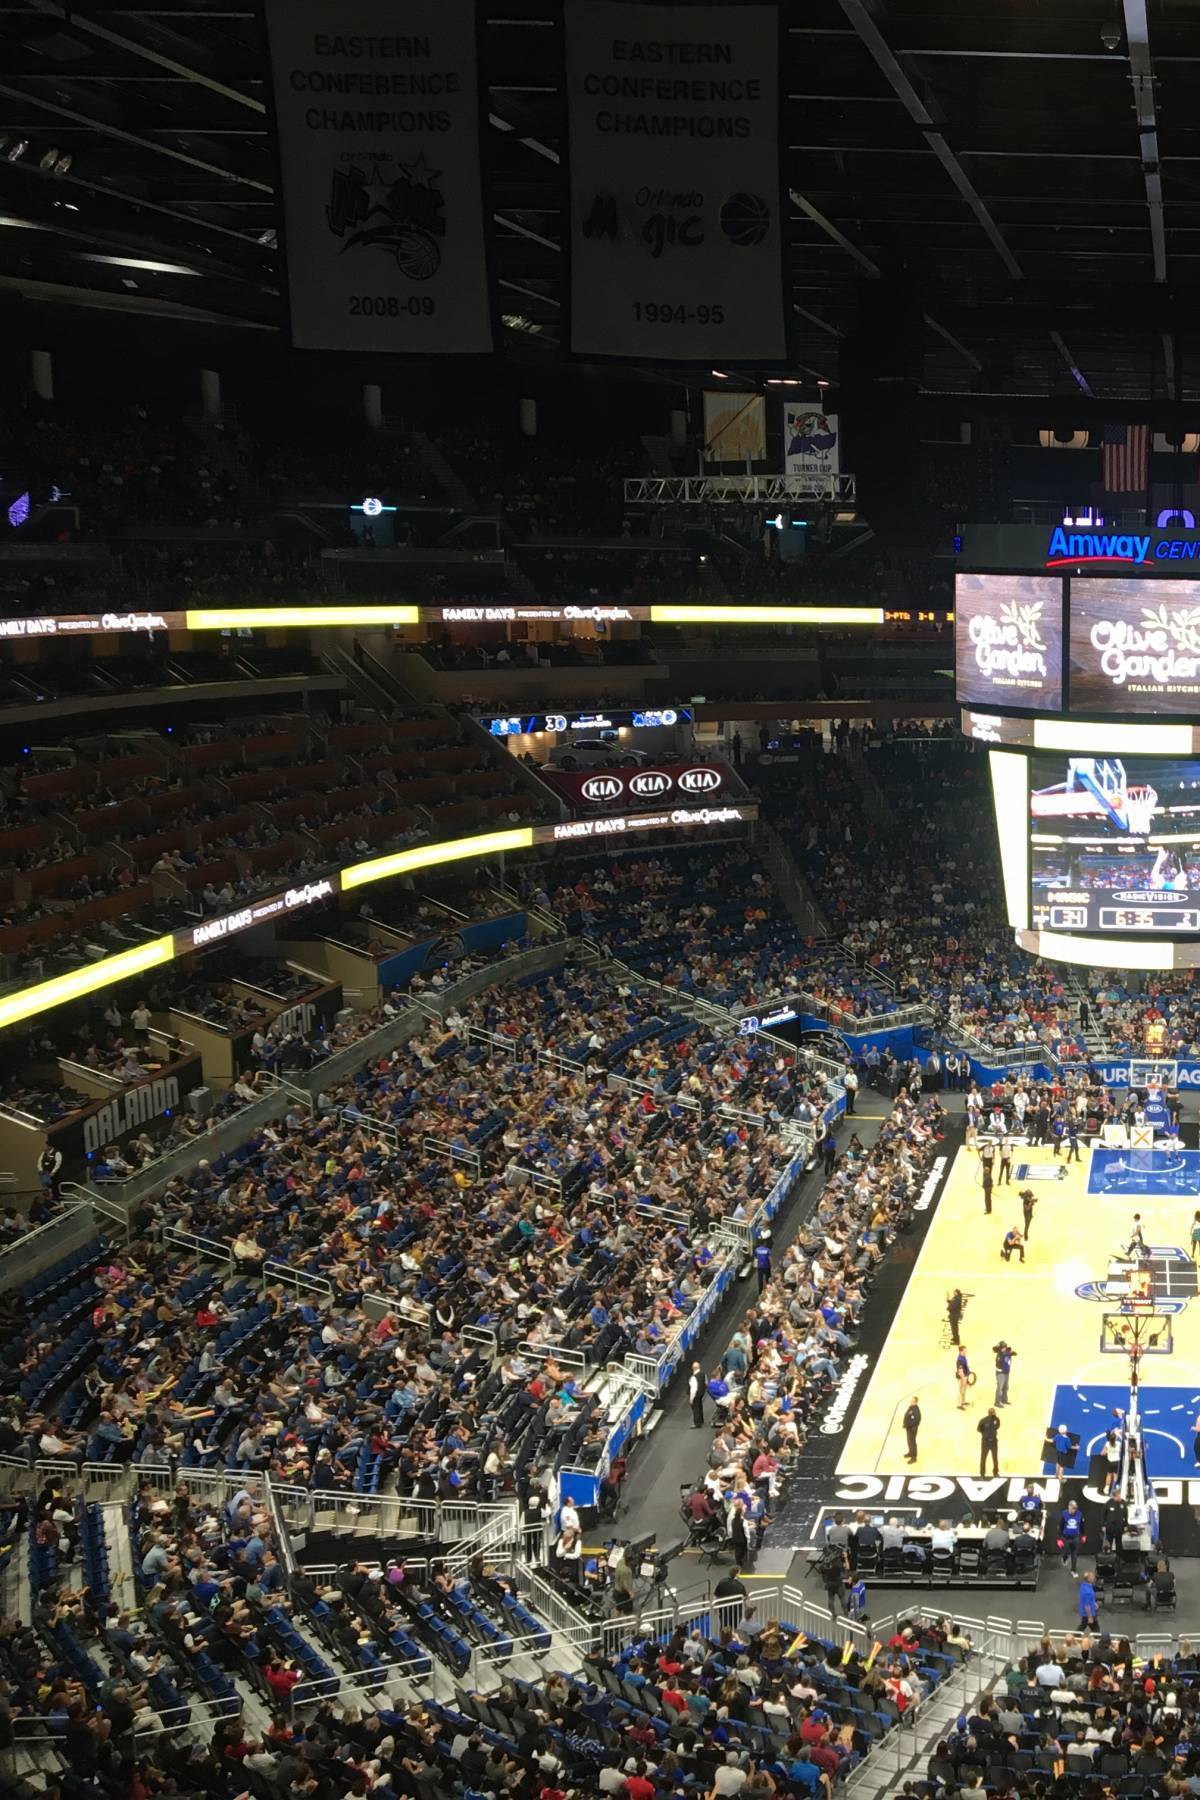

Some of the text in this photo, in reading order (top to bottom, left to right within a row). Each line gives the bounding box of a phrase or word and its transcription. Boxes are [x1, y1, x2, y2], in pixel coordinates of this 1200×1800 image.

[314, 34, 431, 57] EASTERN
[612, 40, 732, 64] EASTERN
[290, 70, 460, 95] CONFERENCE
[584, 73, 761, 100] CONFERENCE
[305, 108, 451, 132] CHAMPIONS
[595, 112, 750, 138] CHAMPIONS
[634, 186, 704, 209] Orlando
[349, 296, 435, 316] 2008-09
[632, 302, 724, 324] 1994-95
[1049, 527, 1150, 565] Amway
[443, 608, 484, 620] FAMILY
[486, 608, 515, 619] DAYS
[0, 620, 26, 636] AMILY
[27, 619, 57, 634] DAYS
[968, 615, 1019, 646] Olive
[1090, 620, 1168, 651] Olive
[975, 643, 1047, 677] Garden
[1128, 684, 1164, 693] ITALIAN
[589, 773, 713, 796] KIA KIA KIA
[554, 822, 594, 838] FAMILY
[595, 818, 625, 833] DAYS
[193, 918, 227, 944] FAMILY
[228, 909, 253, 931] DAYS
[1062, 911, 1081, 924] 34
[1115, 911, 1154, 926] 6:35
[83, 1076, 179, 1150] ORLANDO
[834, 1474, 1060, 1503] MAGIC
